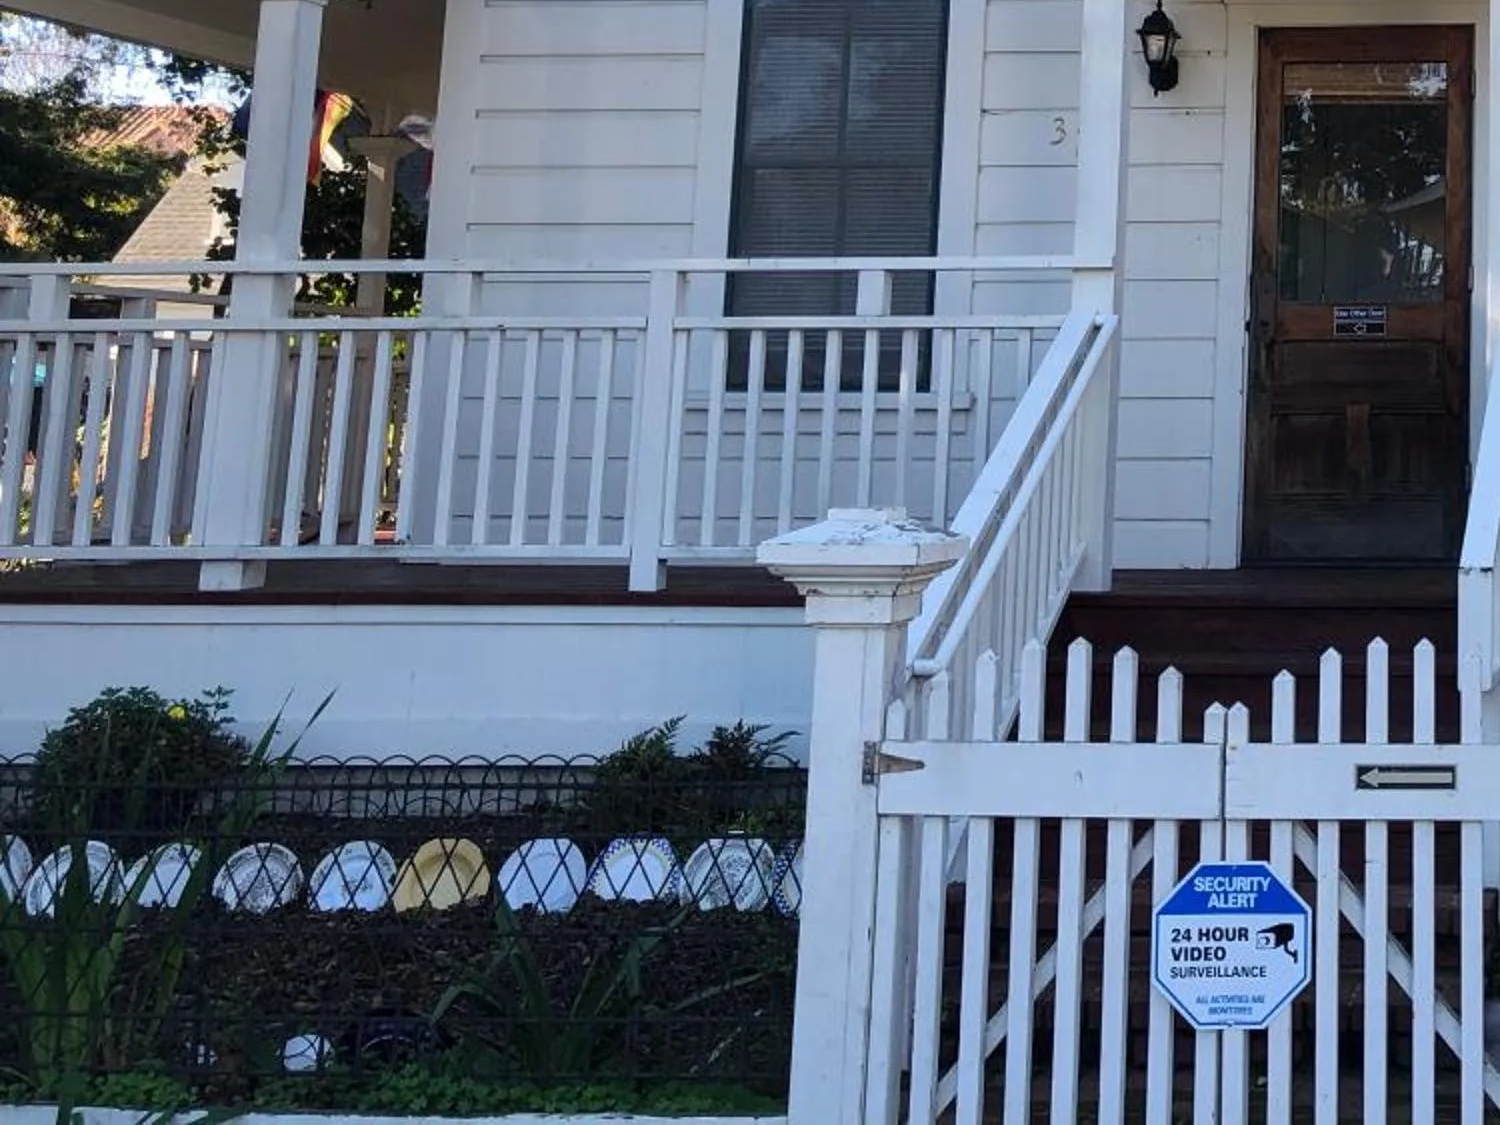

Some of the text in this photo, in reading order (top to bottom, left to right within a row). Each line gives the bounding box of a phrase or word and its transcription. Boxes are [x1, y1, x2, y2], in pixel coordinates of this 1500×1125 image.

[1193, 876, 1272, 892] SECURITY
[1207, 893, 1259, 908] ALERT
[1170, 927, 1249, 943] 24 HOUR
[1170, 946, 1227, 961] VIDEO
[1170, 966, 1268, 980] SURVEILLANCE
